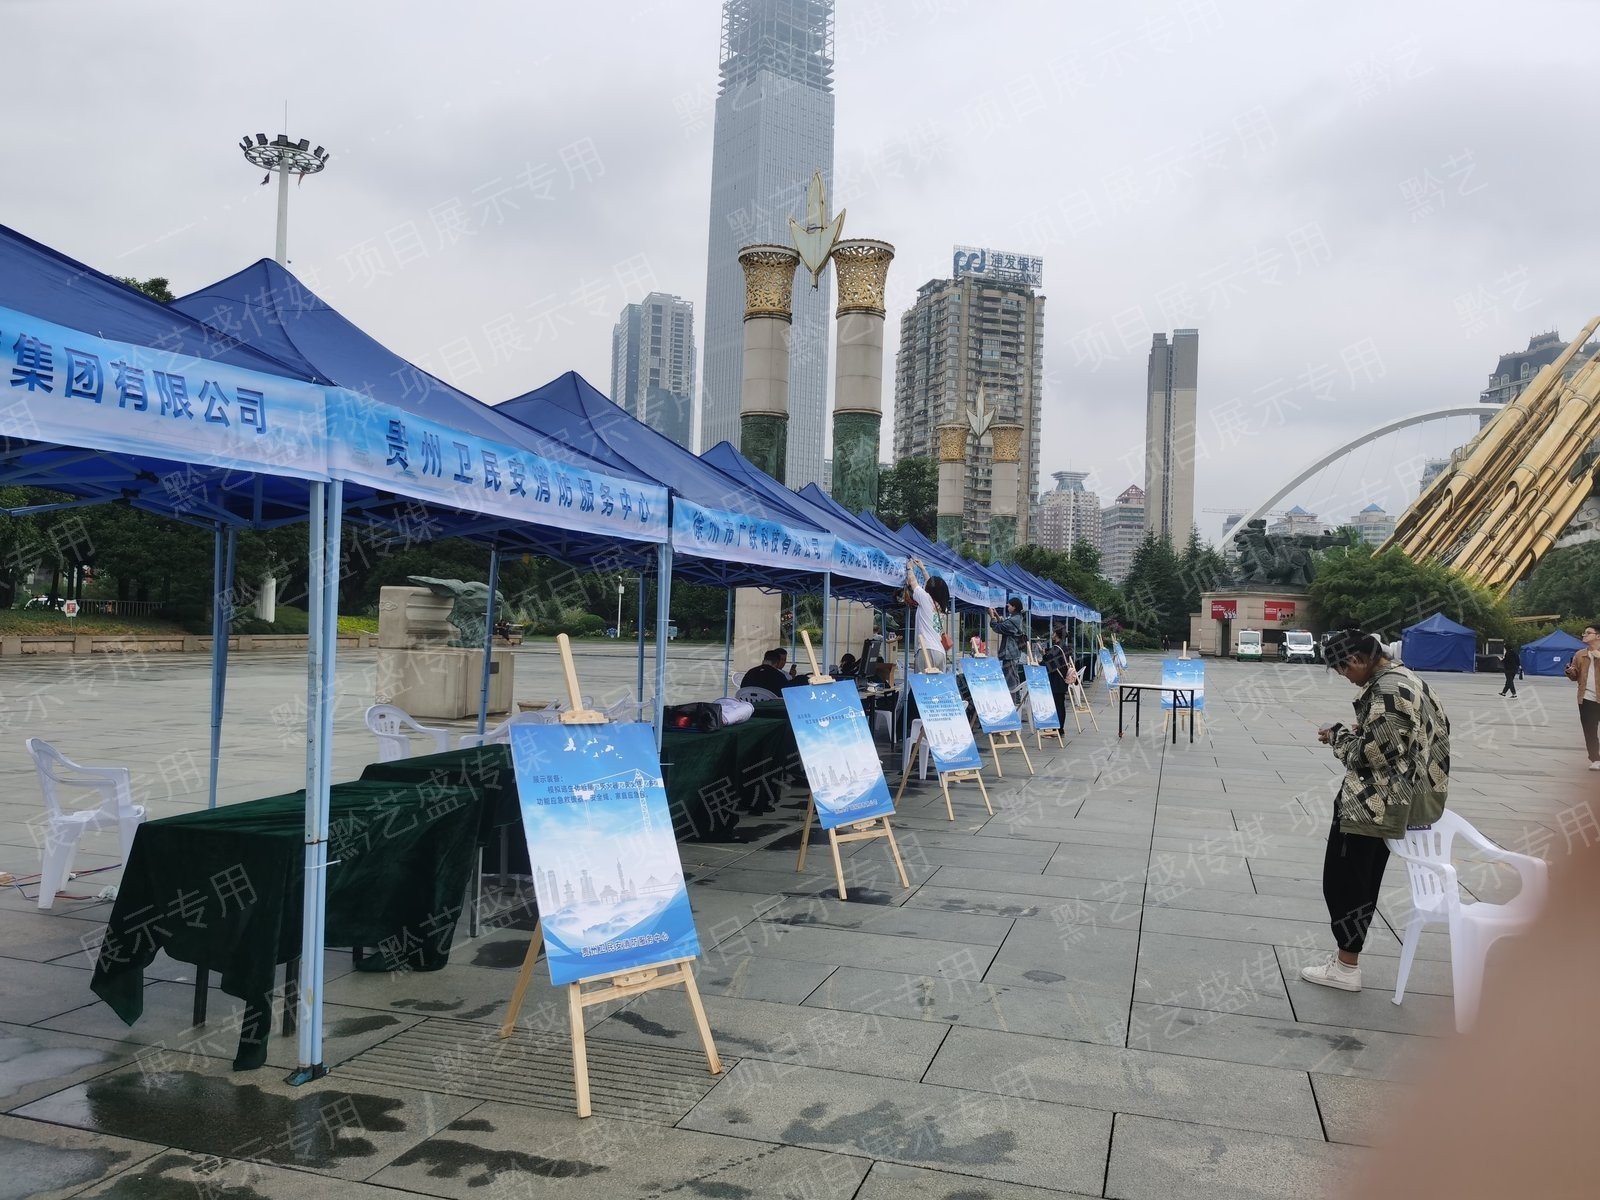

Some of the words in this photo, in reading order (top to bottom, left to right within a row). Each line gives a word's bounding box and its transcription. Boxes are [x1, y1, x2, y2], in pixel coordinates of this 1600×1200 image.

[990, 253, 1043, 273] 浦发银行
[0, 329, 267, 435] 集团有限公司
[386, 418, 651, 523] 贵州卫民安消防服务中心
